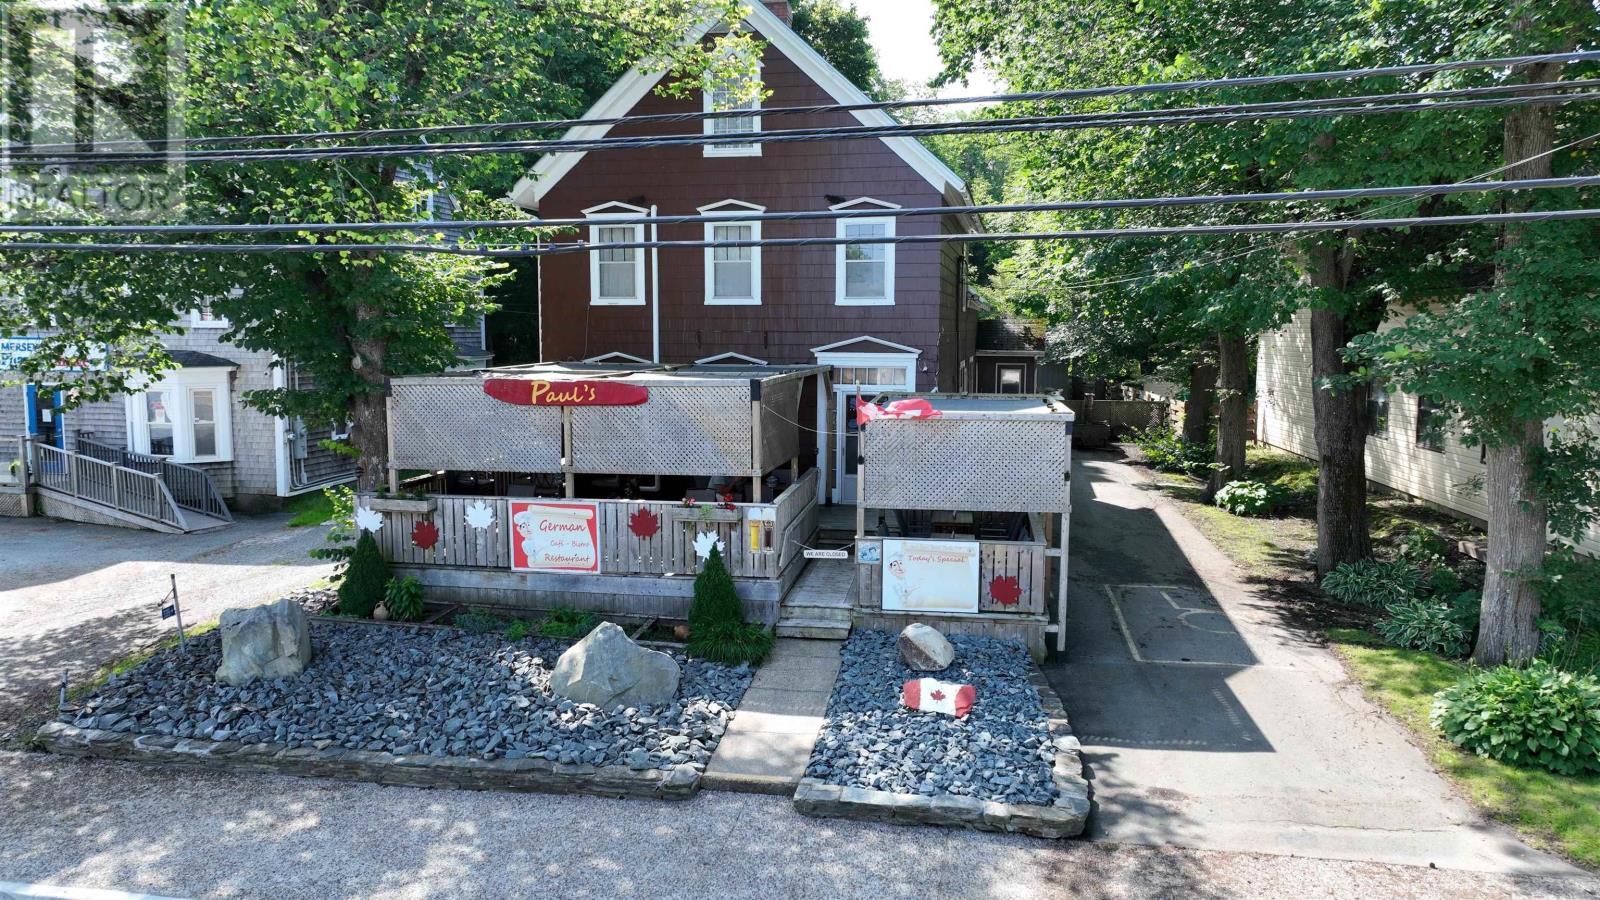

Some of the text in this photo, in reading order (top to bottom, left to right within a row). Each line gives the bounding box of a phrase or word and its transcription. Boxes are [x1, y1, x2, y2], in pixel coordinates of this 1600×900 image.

[530, 380, 596, 404] Paul's
[539, 519, 586, 532] German
[544, 553, 591, 562] Restaurant
[908, 554, 966, 564] Today's Special
